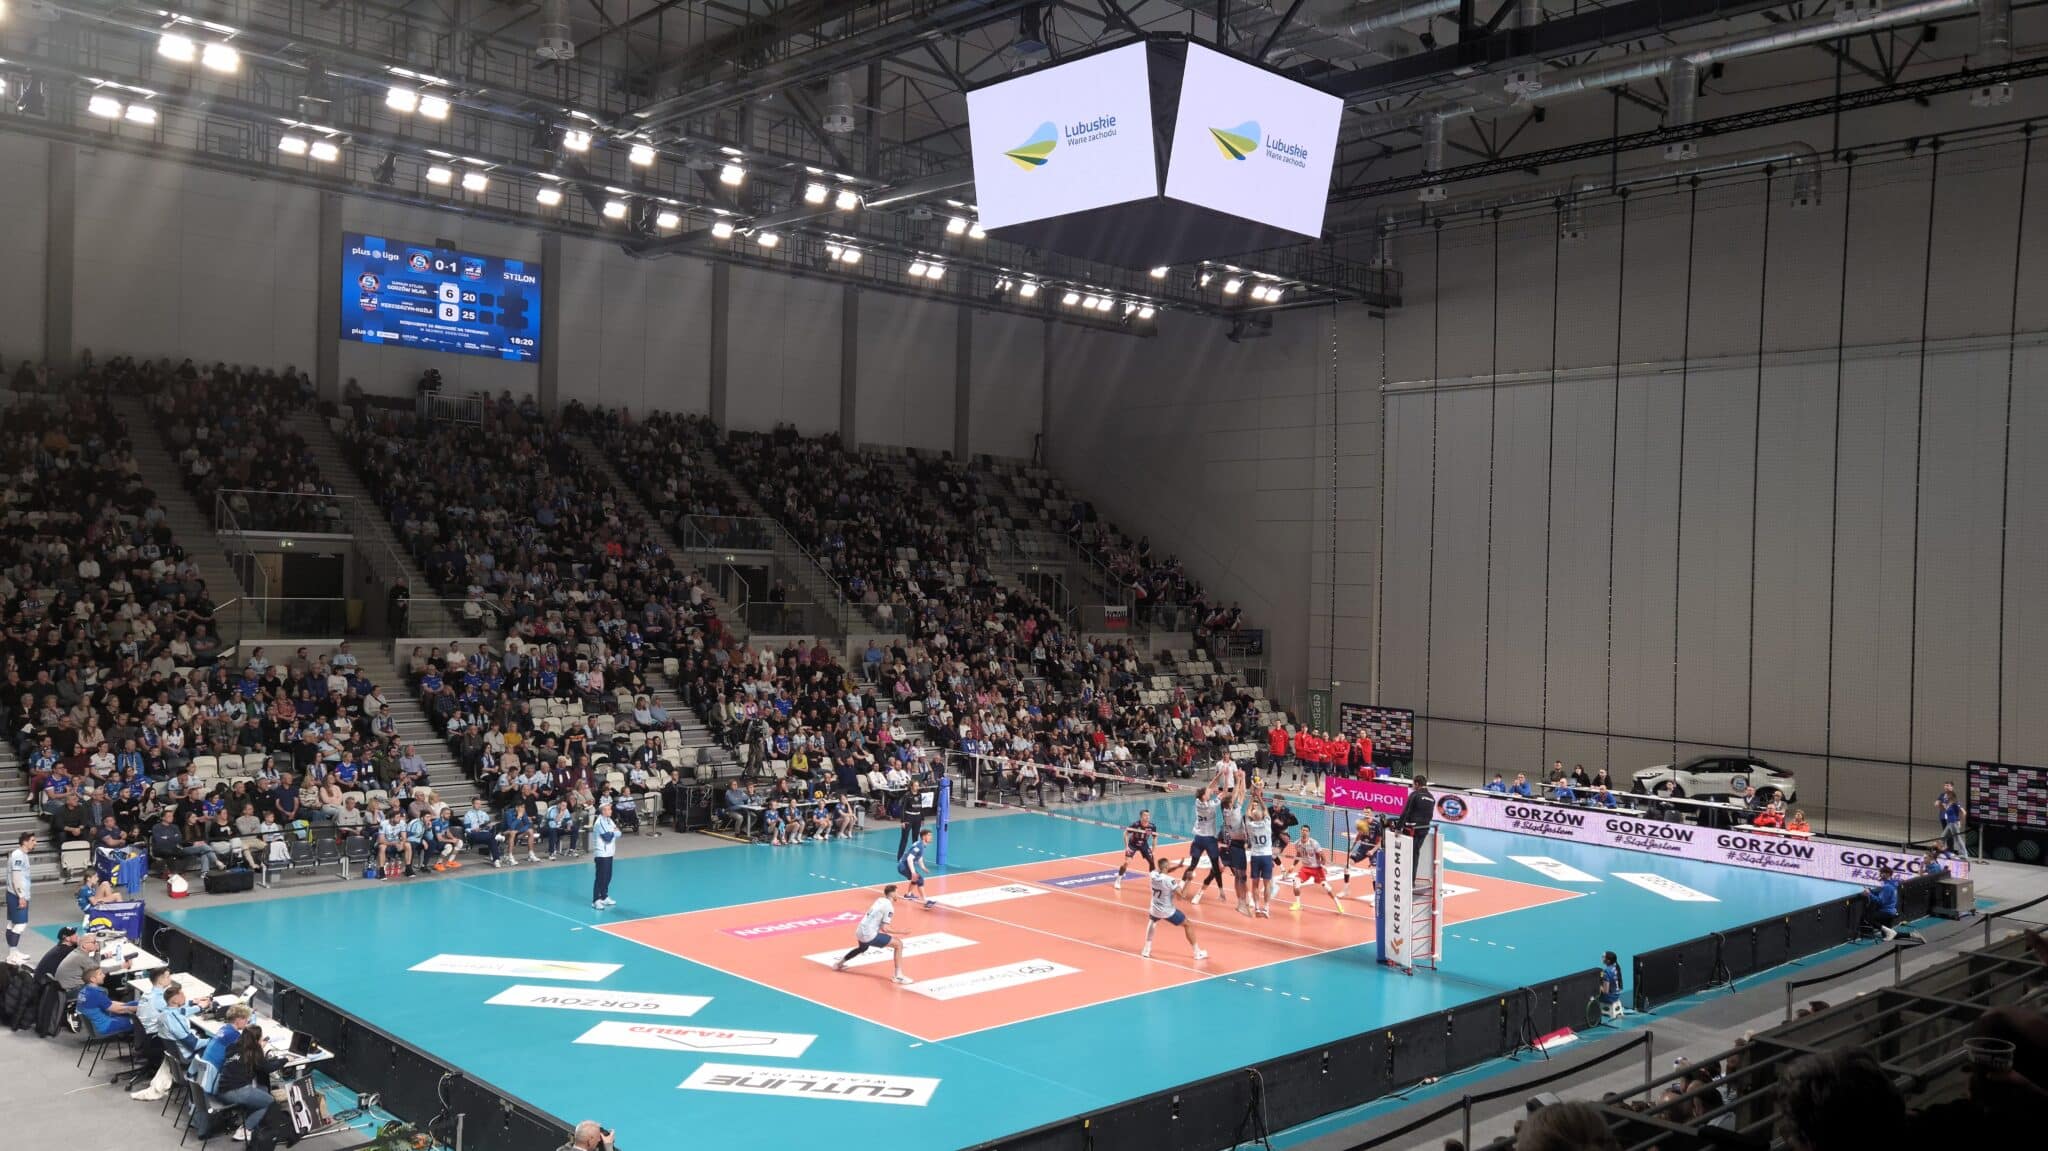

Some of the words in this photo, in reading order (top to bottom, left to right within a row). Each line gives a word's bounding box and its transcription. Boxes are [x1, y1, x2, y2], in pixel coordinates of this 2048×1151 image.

[1065, 114, 1117, 138] Lubuskie
[1067, 134, 1087, 147] Warte
[1088, 128, 1117, 143] zachodu
[1266, 135, 1308, 160] Lubuskie
[1265, 148, 1282, 161] Warte
[1281, 152, 1306, 169] zachodu
[352, 247, 371, 257] plus
[503, 272, 536, 284] STILON
[446, 289, 454, 299] 6
[462, 292, 476, 302] 20
[445, 307, 453, 317] 8
[462, 310, 476, 320] 25
[351, 327, 366, 335] plus
[1349, 789, 1404, 806] TAURON
[1505, 805, 1585, 826] GORZÓW
[1606, 819, 1694, 842] GORZÓW
[1254, 835, 1267, 845] 10
[1717, 834, 1815, 859] GORZÓW
[1840, 850, 1921, 874] GORZÓ
[1393, 841, 1402, 934] KRISHOME
[734, 917, 833, 937] TAURON
[531, 994, 661, 1011] GORZÓW
[628, 1025, 735, 1039] RAJBUD
[703, 1073, 915, 1099] CUTLINE
